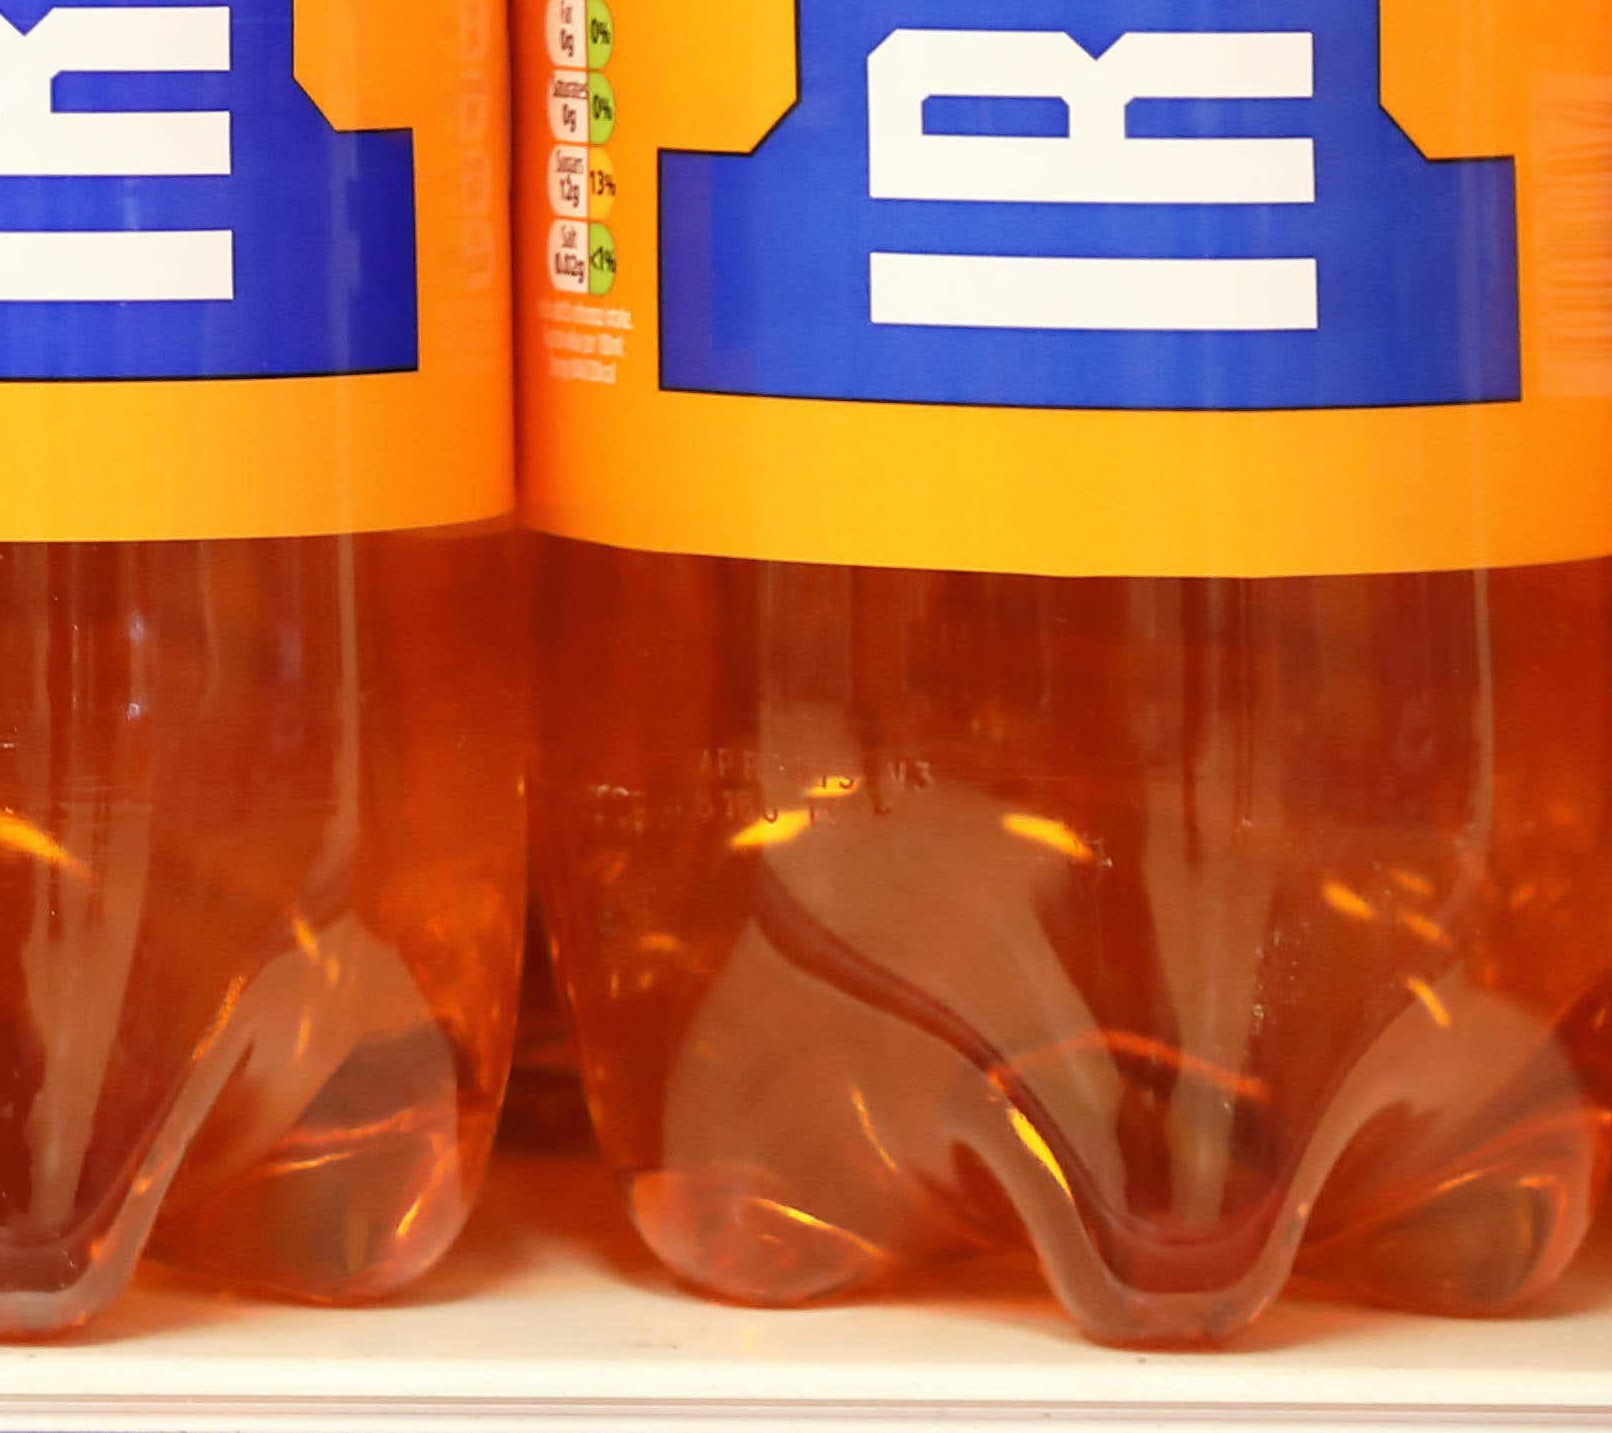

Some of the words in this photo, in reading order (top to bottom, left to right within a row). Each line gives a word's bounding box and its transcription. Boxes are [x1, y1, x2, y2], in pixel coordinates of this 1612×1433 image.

[590, 18, 611, 45] 0%
[592, 94, 613, 121] 0%
[589, 170, 617, 197] 13%
